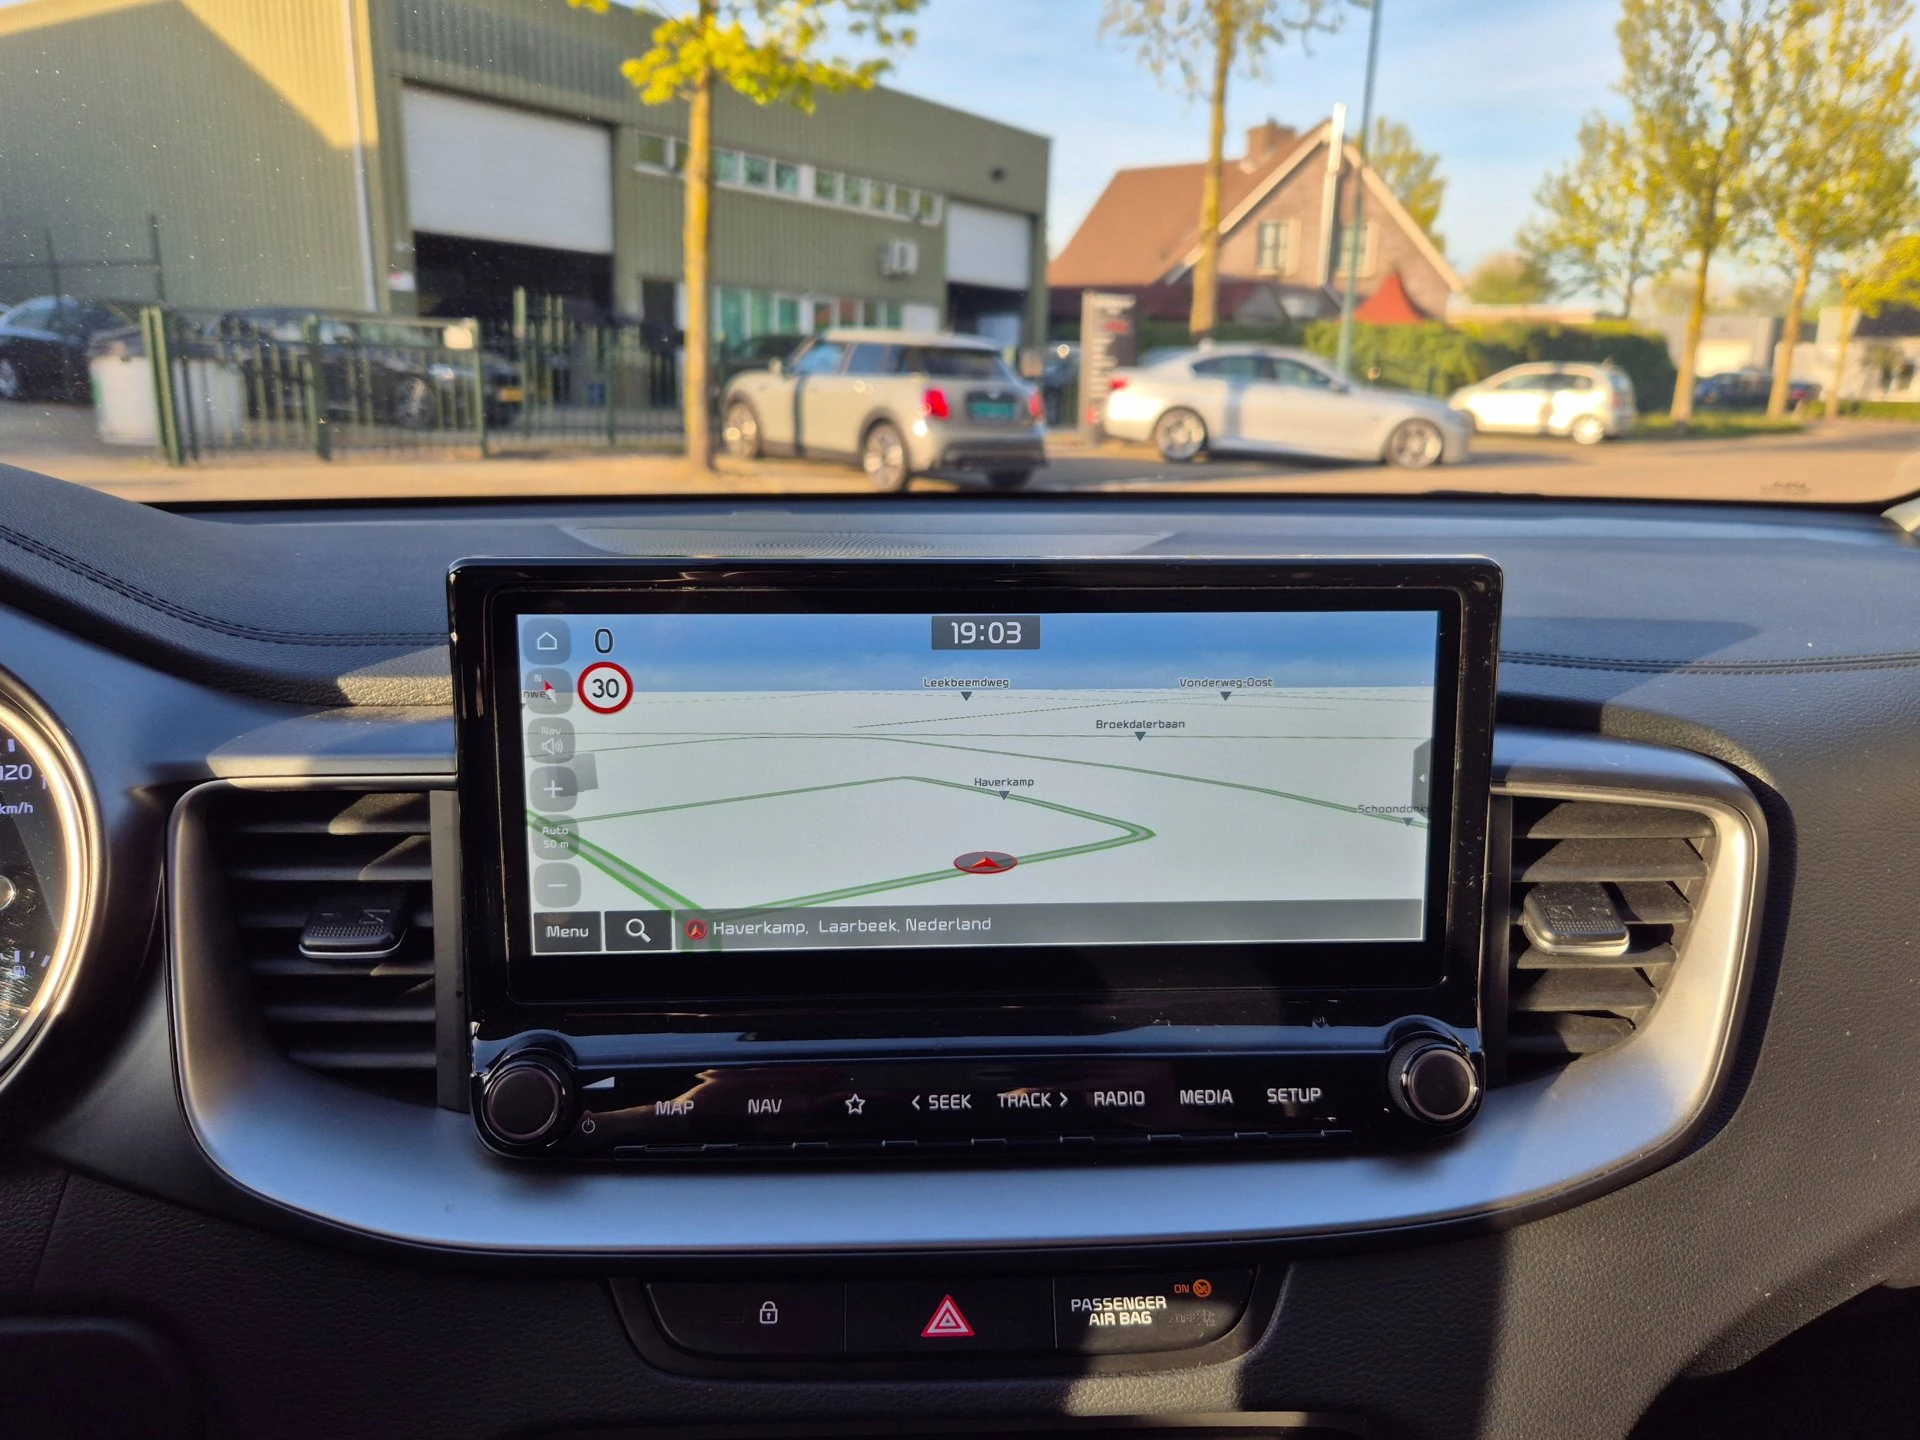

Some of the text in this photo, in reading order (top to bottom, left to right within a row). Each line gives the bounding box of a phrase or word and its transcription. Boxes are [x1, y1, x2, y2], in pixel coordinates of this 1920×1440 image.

[951, 621, 1021, 644] 19:03
[594, 628, 614, 654] 0
[592, 678, 620, 699] 30
[923, 678, 1009, 689] Leekbeemdweg
[1179, 677, 1273, 688] Vonderweg-Oost
[540, 726, 561, 736] Nav
[1095, 719, 1185, 729] Broekdalerbaan
[0, 763, 33, 780] 120
[974, 777, 1035, 788] Haverkamp
[0, 802, 34, 814] km/h
[542, 826, 569, 835] Auto
[543, 840, 557, 849] 50
[546, 925, 589, 938] Menu
[713, 917, 992, 938] Haverkamp, Laarbeek, Nederland
[928, 1094, 972, 1110] SEEK
[997, 1092, 1052, 1108] TRACK
[1094, 1090, 1145, 1106] RADIO
[1179, 1089, 1234, 1105] MEDIA
[1266, 1087, 1322, 1103] SETUP
[655, 1100, 695, 1116] MAP
[747, 1098, 782, 1113] NAV
[1174, 1284, 1190, 1294] ON
[1071, 1295, 1168, 1312] PASSENGER
[1088, 1312, 1116, 1326] AIR
[1119, 1311, 1152, 1326] BAG
